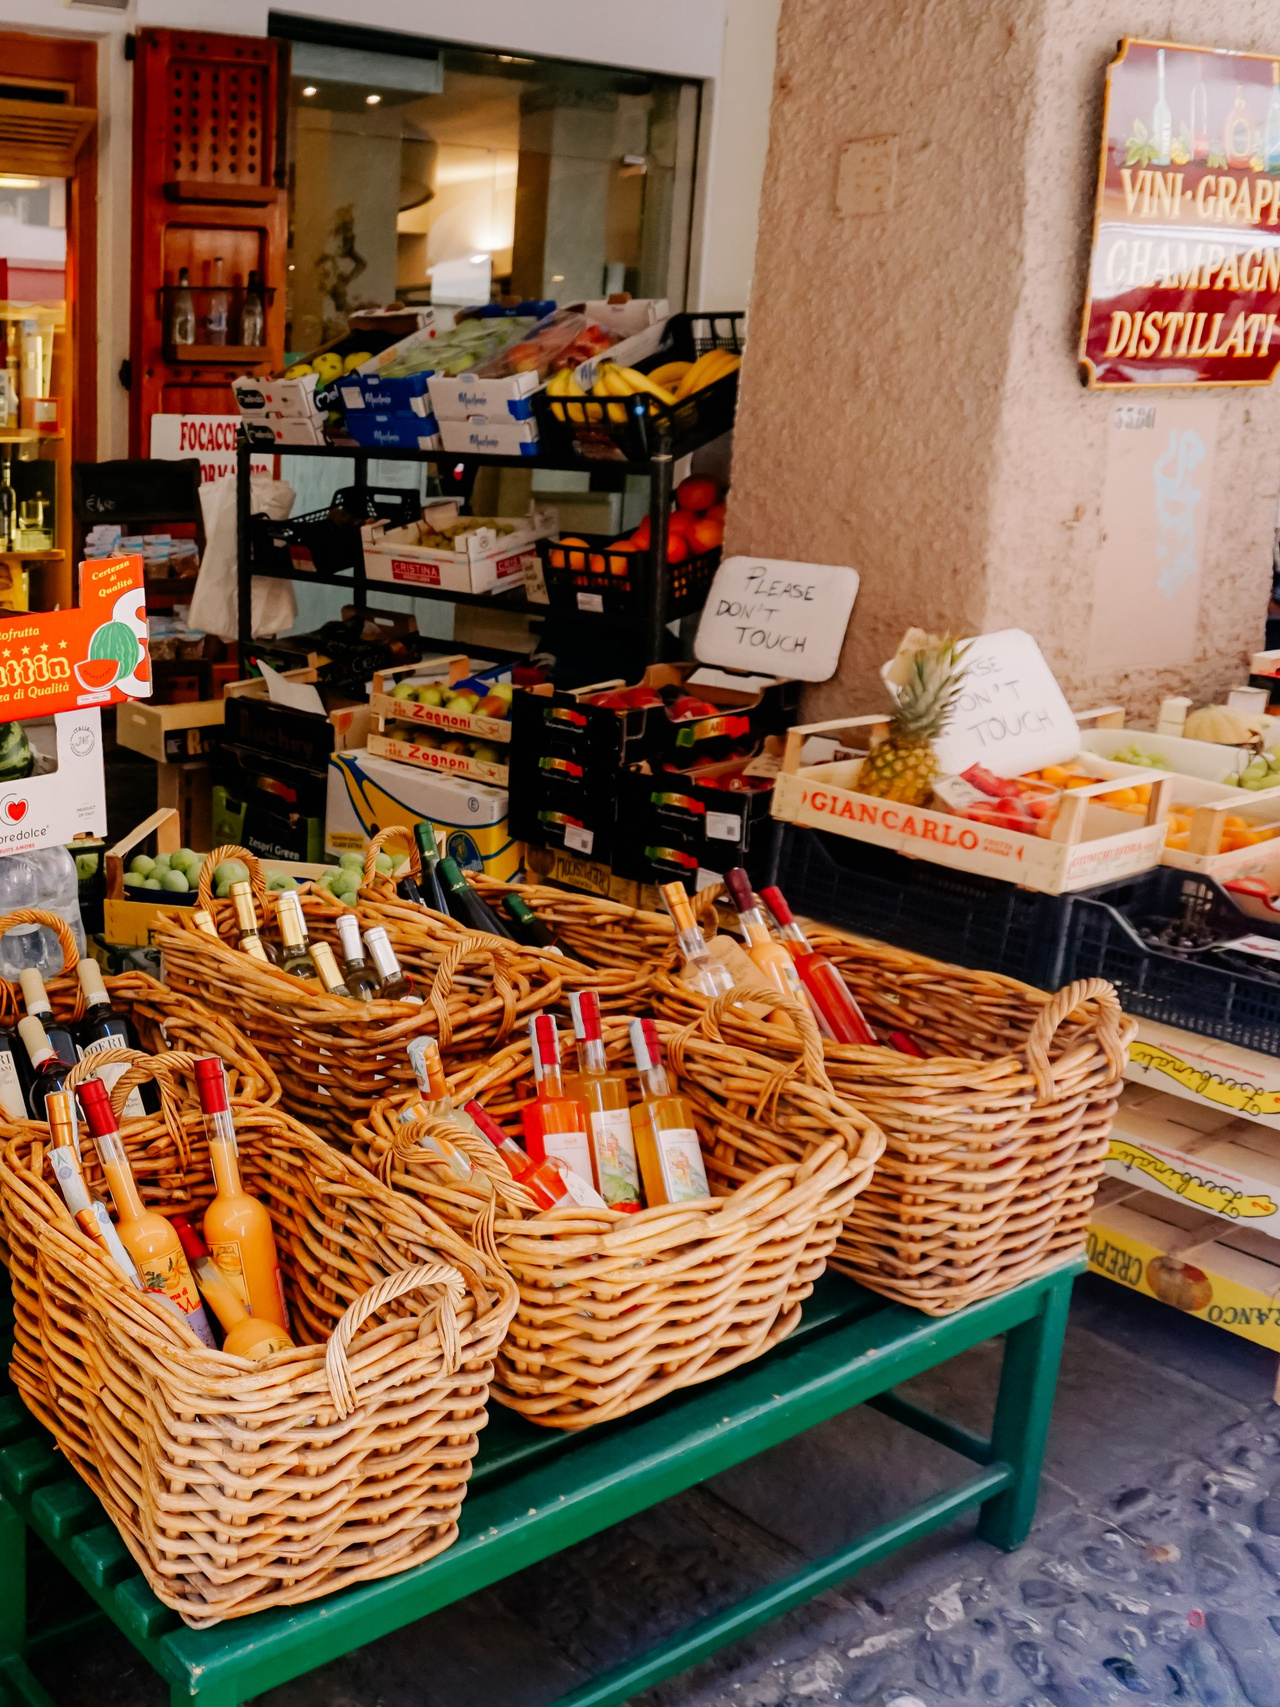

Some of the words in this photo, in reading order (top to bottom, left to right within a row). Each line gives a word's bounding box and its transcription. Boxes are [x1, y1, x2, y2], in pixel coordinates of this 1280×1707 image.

[1104, 310, 1277, 358] DISTILLATI
[91, 559, 130, 581] Certezza
[109, 573, 118, 582] di
[393, 562, 438, 577] CRISTINA
[98, 576, 134, 598] Qualità
[743, 565, 817, 601] PLEASE
[716, 599, 780, 622] DON'T
[736, 626, 808, 653] TOUCH
[13, 688, 25, 700] di
[27, 681, 70, 698] Qualità
[952, 680, 1021, 712] ON'T
[412, 704, 471, 729] Zagnoni
[967, 707, 1055, 747] TOUCH
[408, 744, 470, 771] Zagnoni
[811, 791, 979, 850] GIANCARLO
[15, 842, 35, 851] AMORE
[248, 836, 274, 855] Zespri
[274, 844, 300, 861] Green
